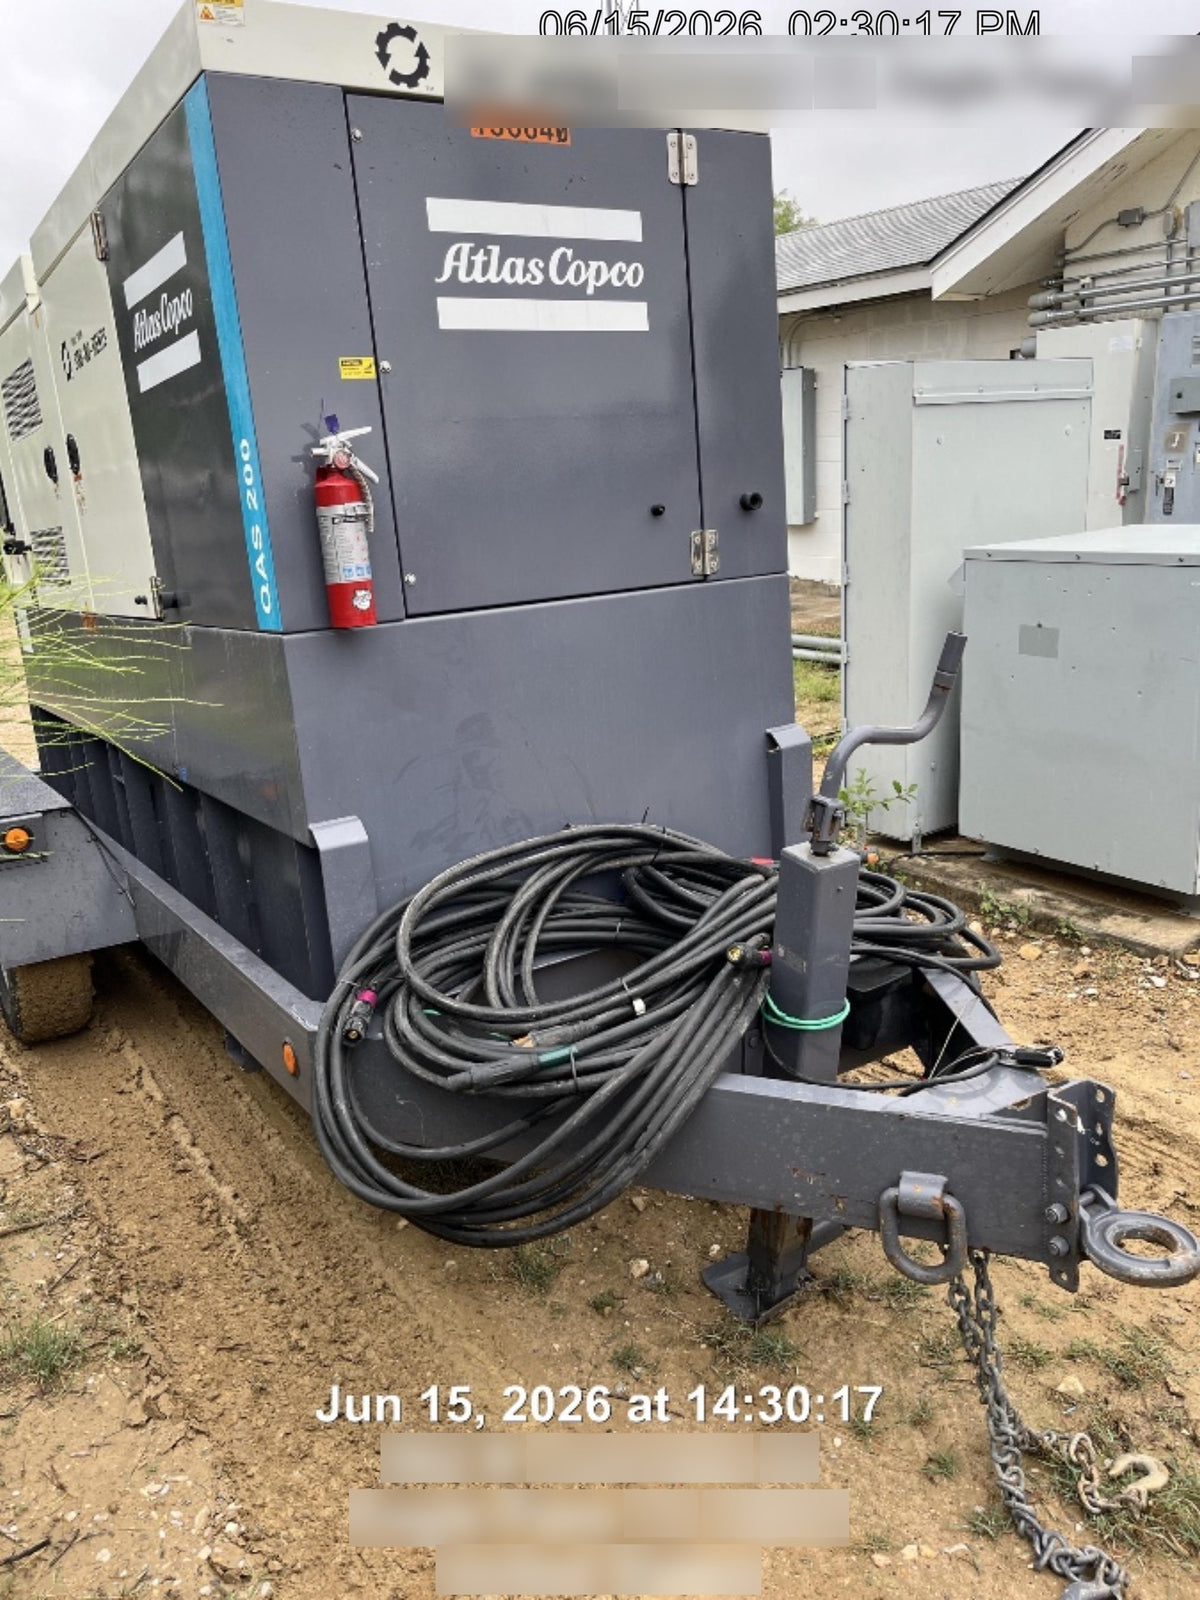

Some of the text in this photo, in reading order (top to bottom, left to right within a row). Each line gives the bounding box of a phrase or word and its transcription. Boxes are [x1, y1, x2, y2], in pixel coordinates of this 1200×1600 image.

[434, 241, 645, 296] Atlas Copco
[133, 309, 162, 353] Atlas
[160, 288, 193, 335] Copco
[239, 438, 272, 614] QAS 200
